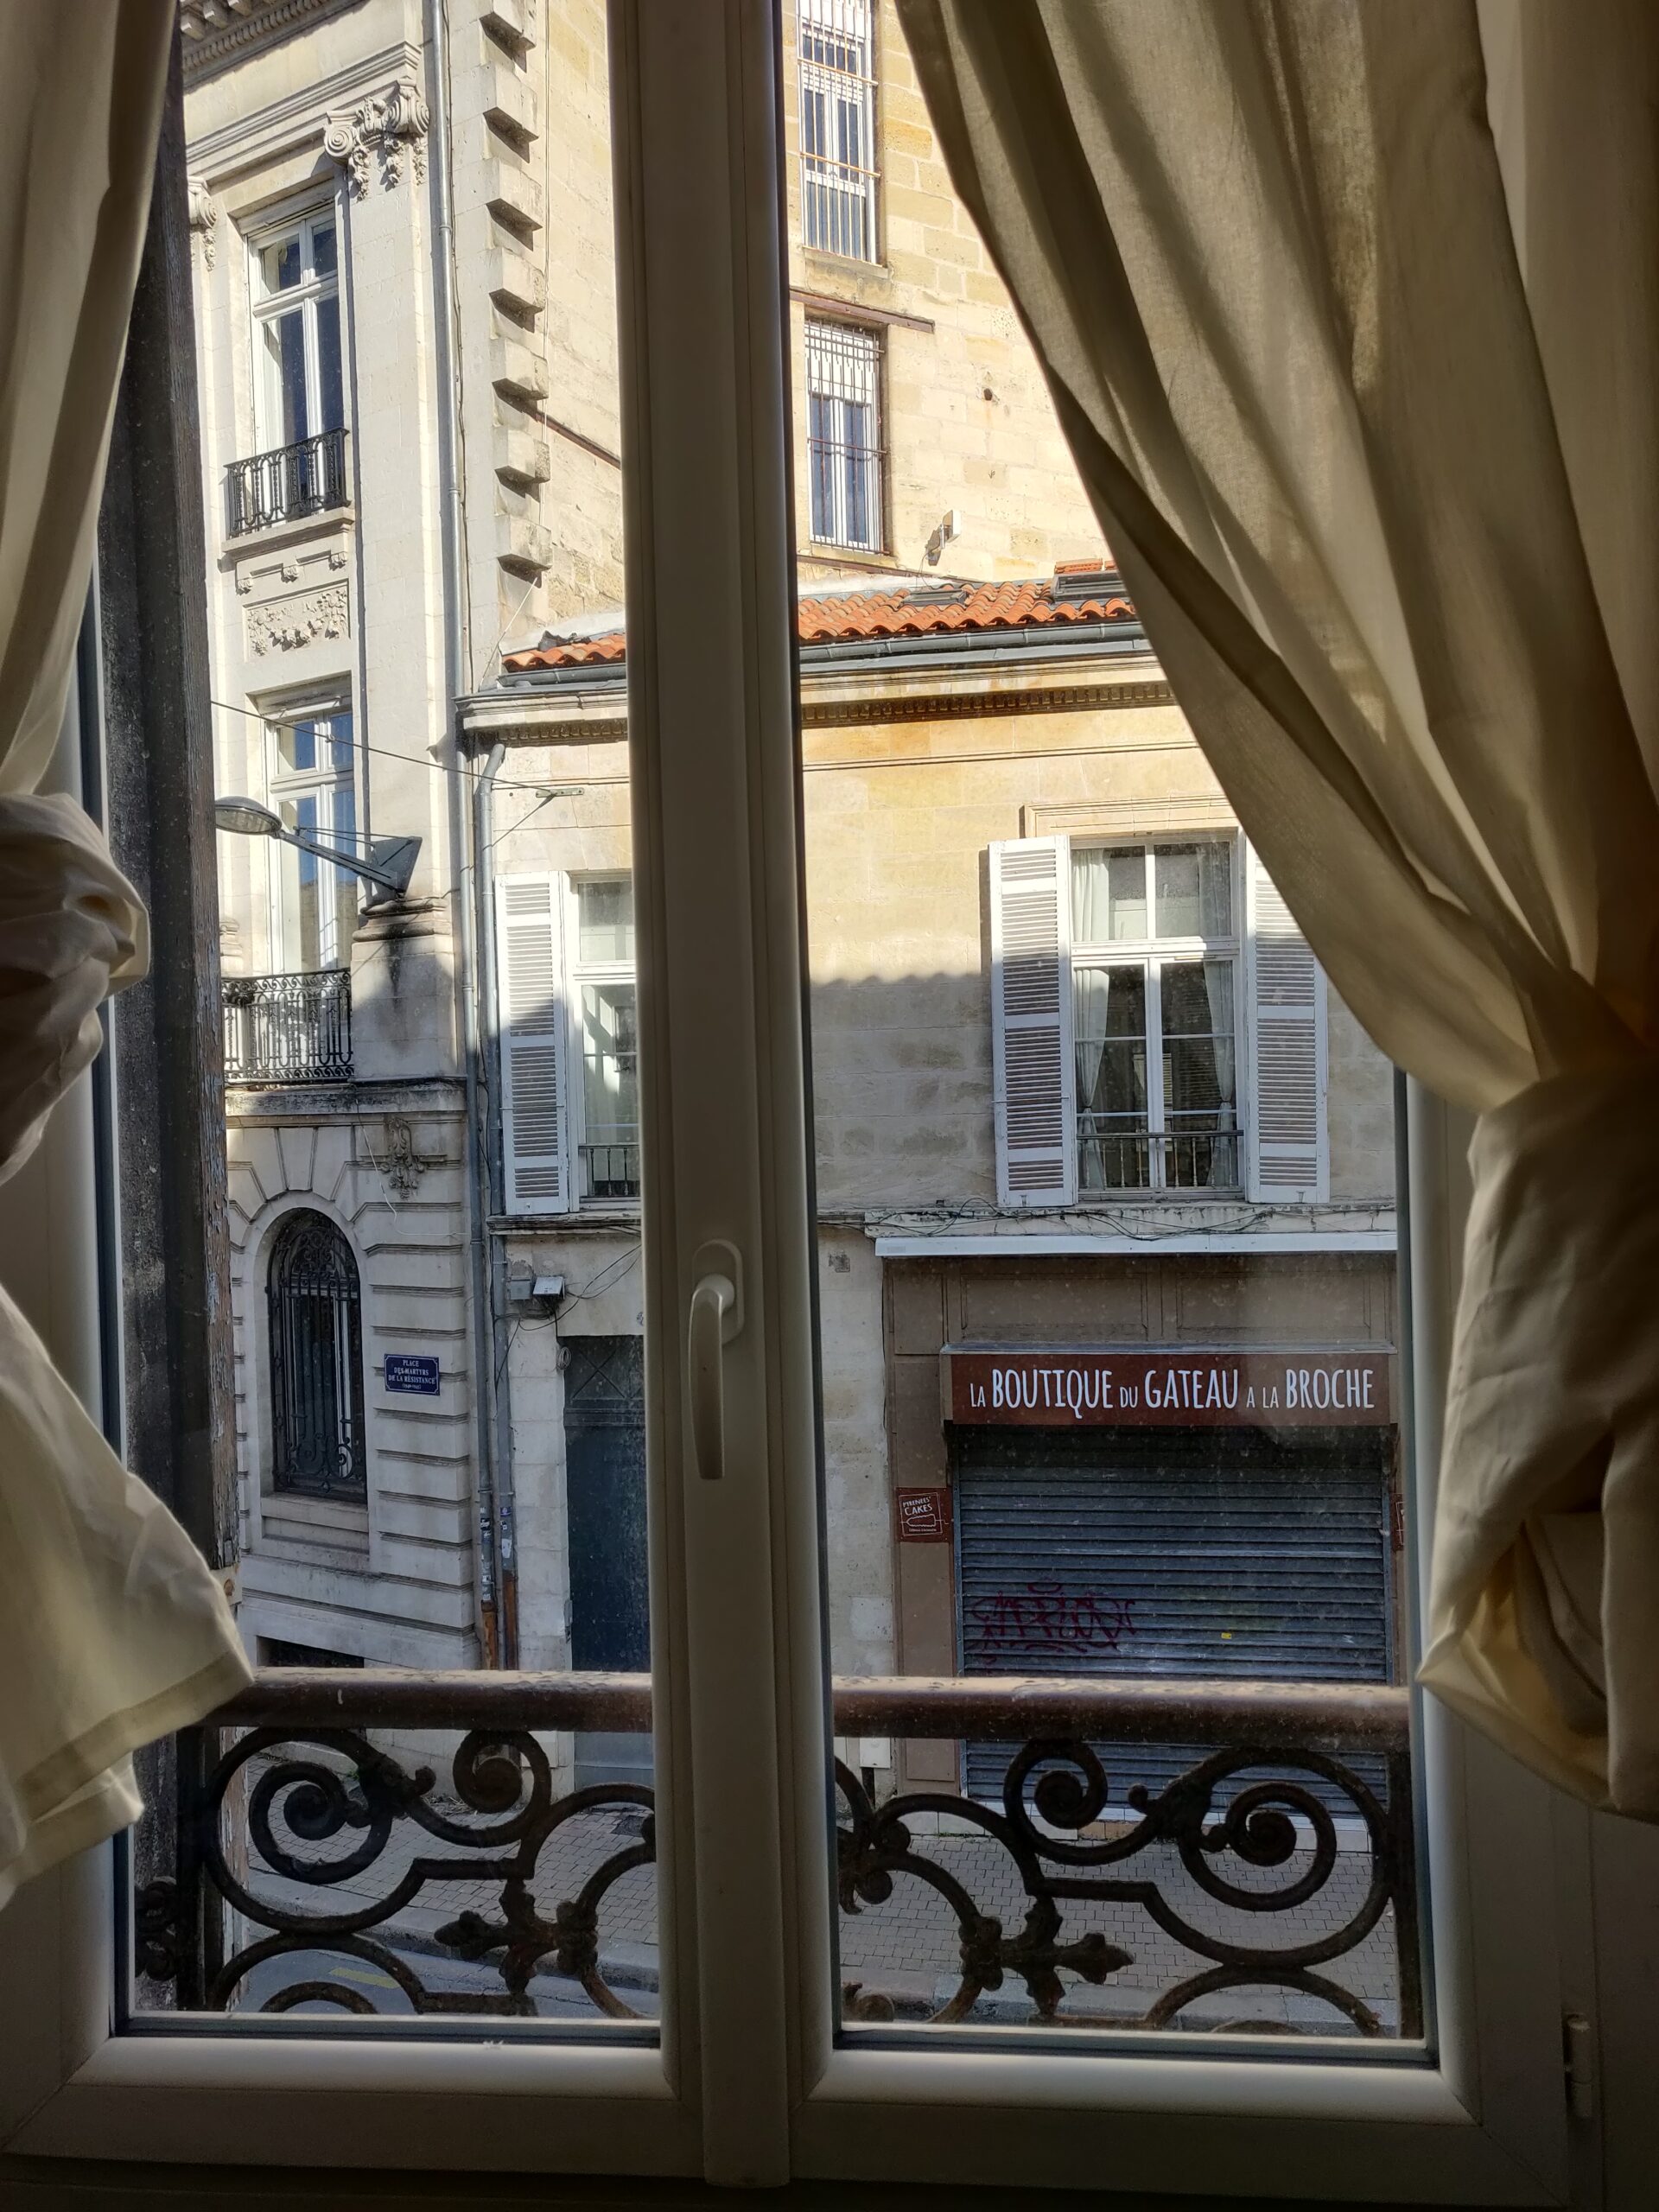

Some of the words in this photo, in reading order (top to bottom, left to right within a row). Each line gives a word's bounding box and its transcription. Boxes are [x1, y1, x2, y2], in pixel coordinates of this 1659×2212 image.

[969, 1382, 986, 1408] LA
[992, 1369, 1113, 1419] BOUTIQUE
[1120, 1386, 1138, 1408] DU
[1144, 1369, 1238, 1408] GATEAU
[1246, 1386, 1255, 1408] A
[1262, 1386, 1279, 1408] LA
[1286, 1369, 1375, 1409] BROCHE
[904, 1503, 932, 1516] CAKES
